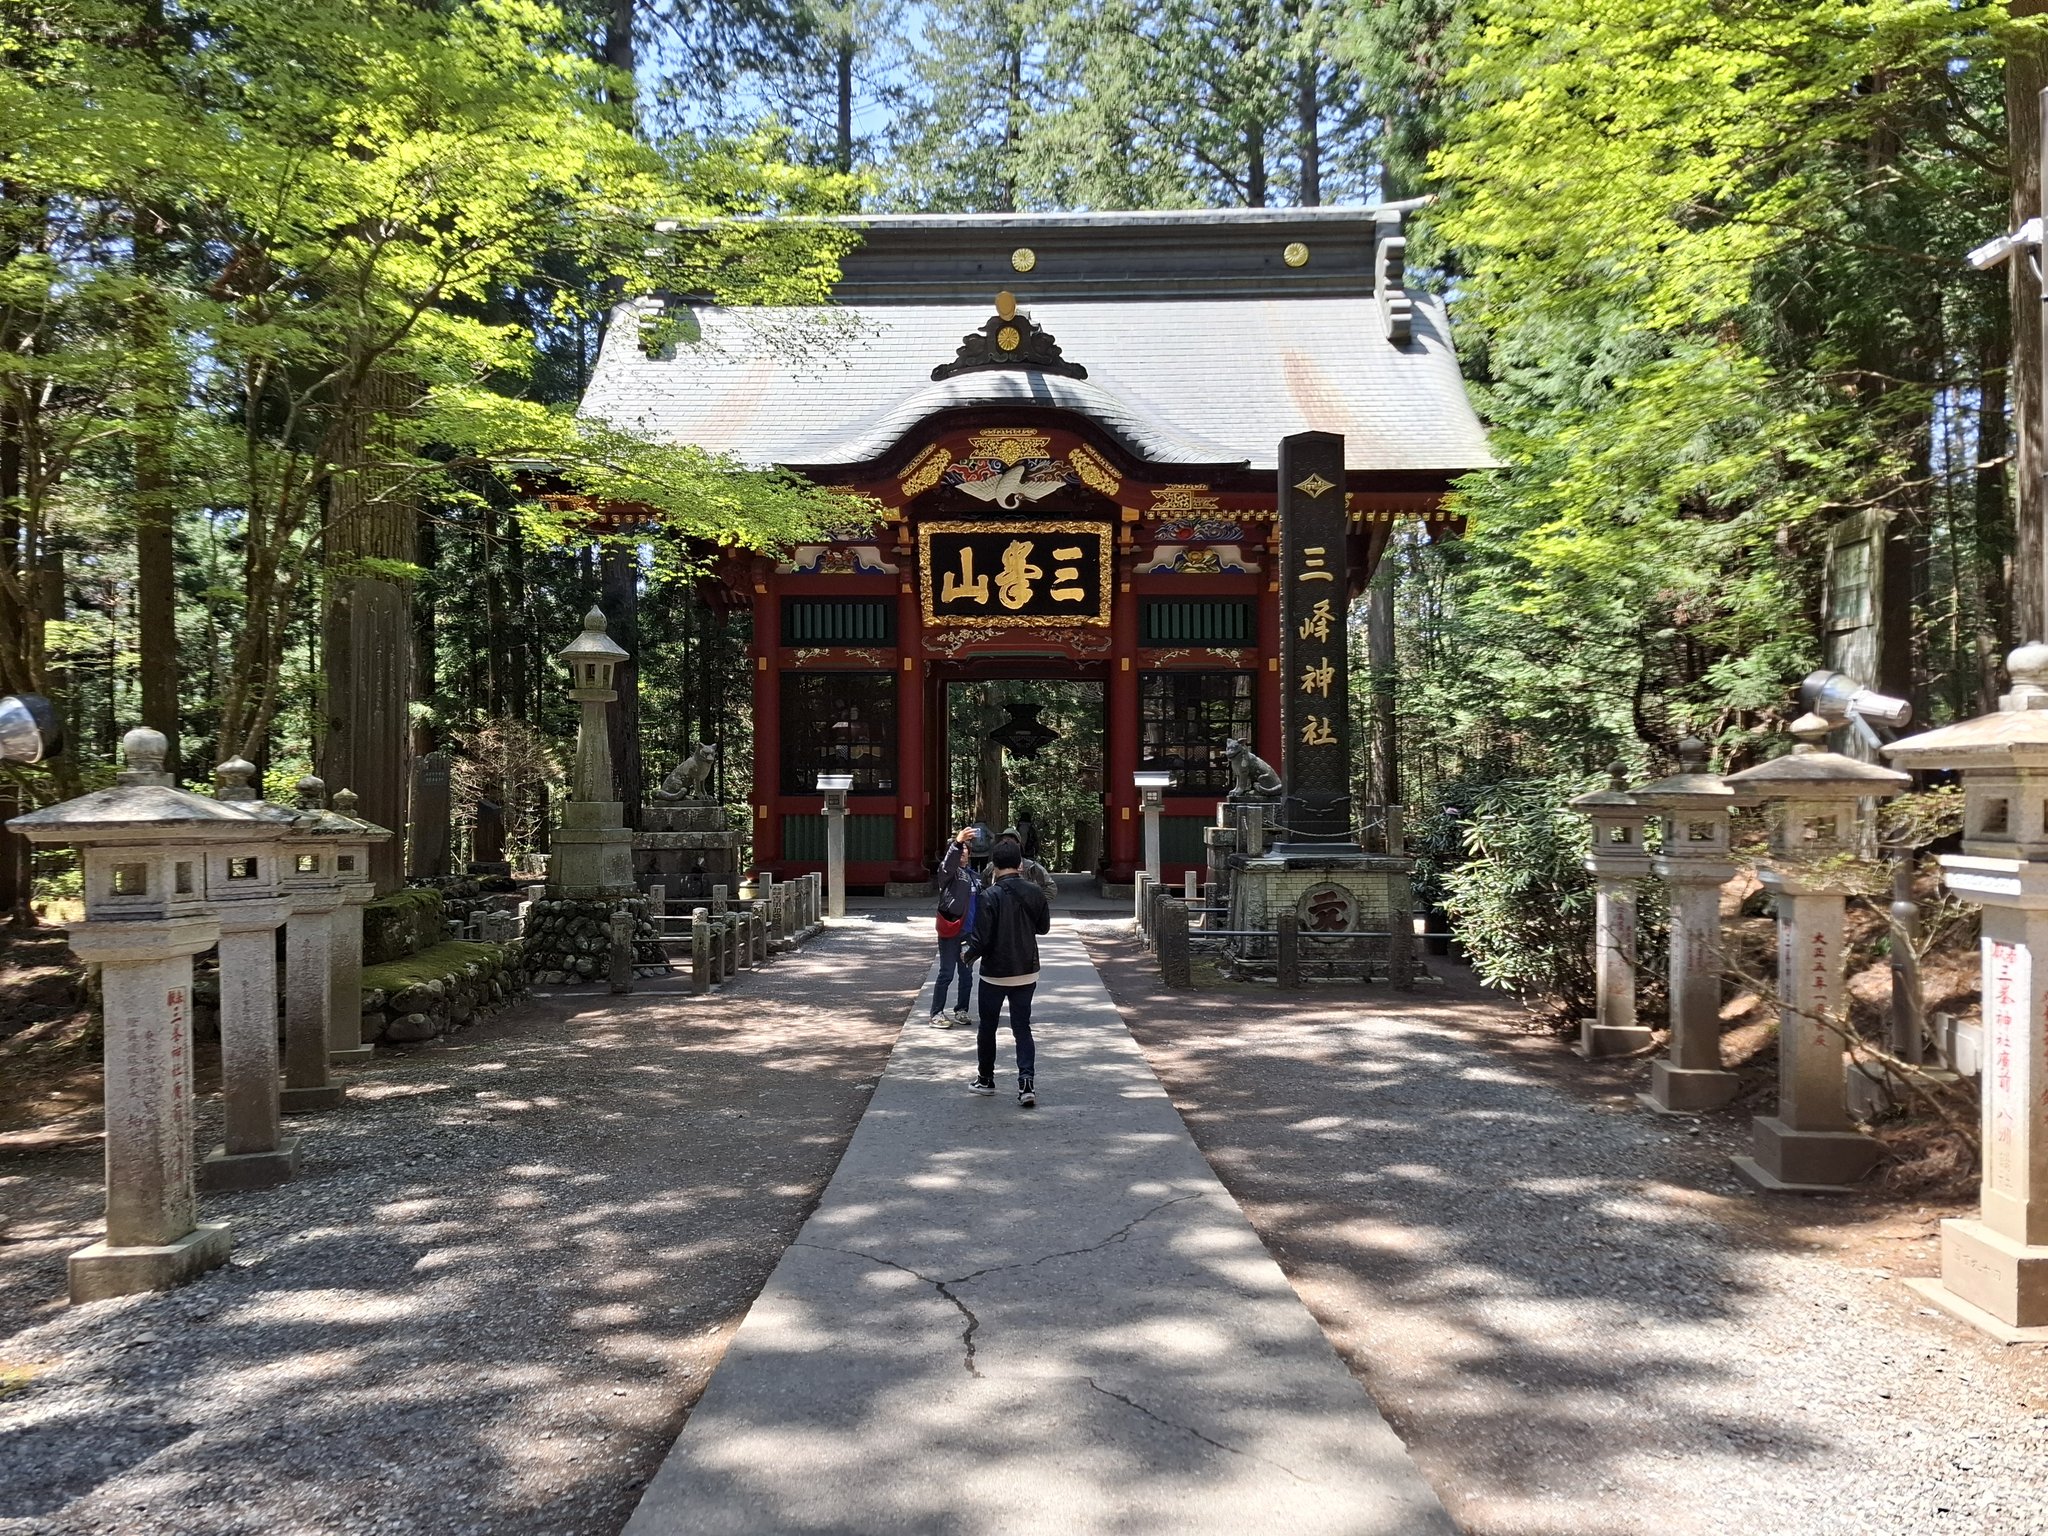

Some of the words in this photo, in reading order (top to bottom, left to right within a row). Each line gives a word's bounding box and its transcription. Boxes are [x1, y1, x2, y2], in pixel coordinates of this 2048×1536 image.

[1299, 547, 1338, 745] 三峰神社
[1308, 890, 1349, 932] 元
